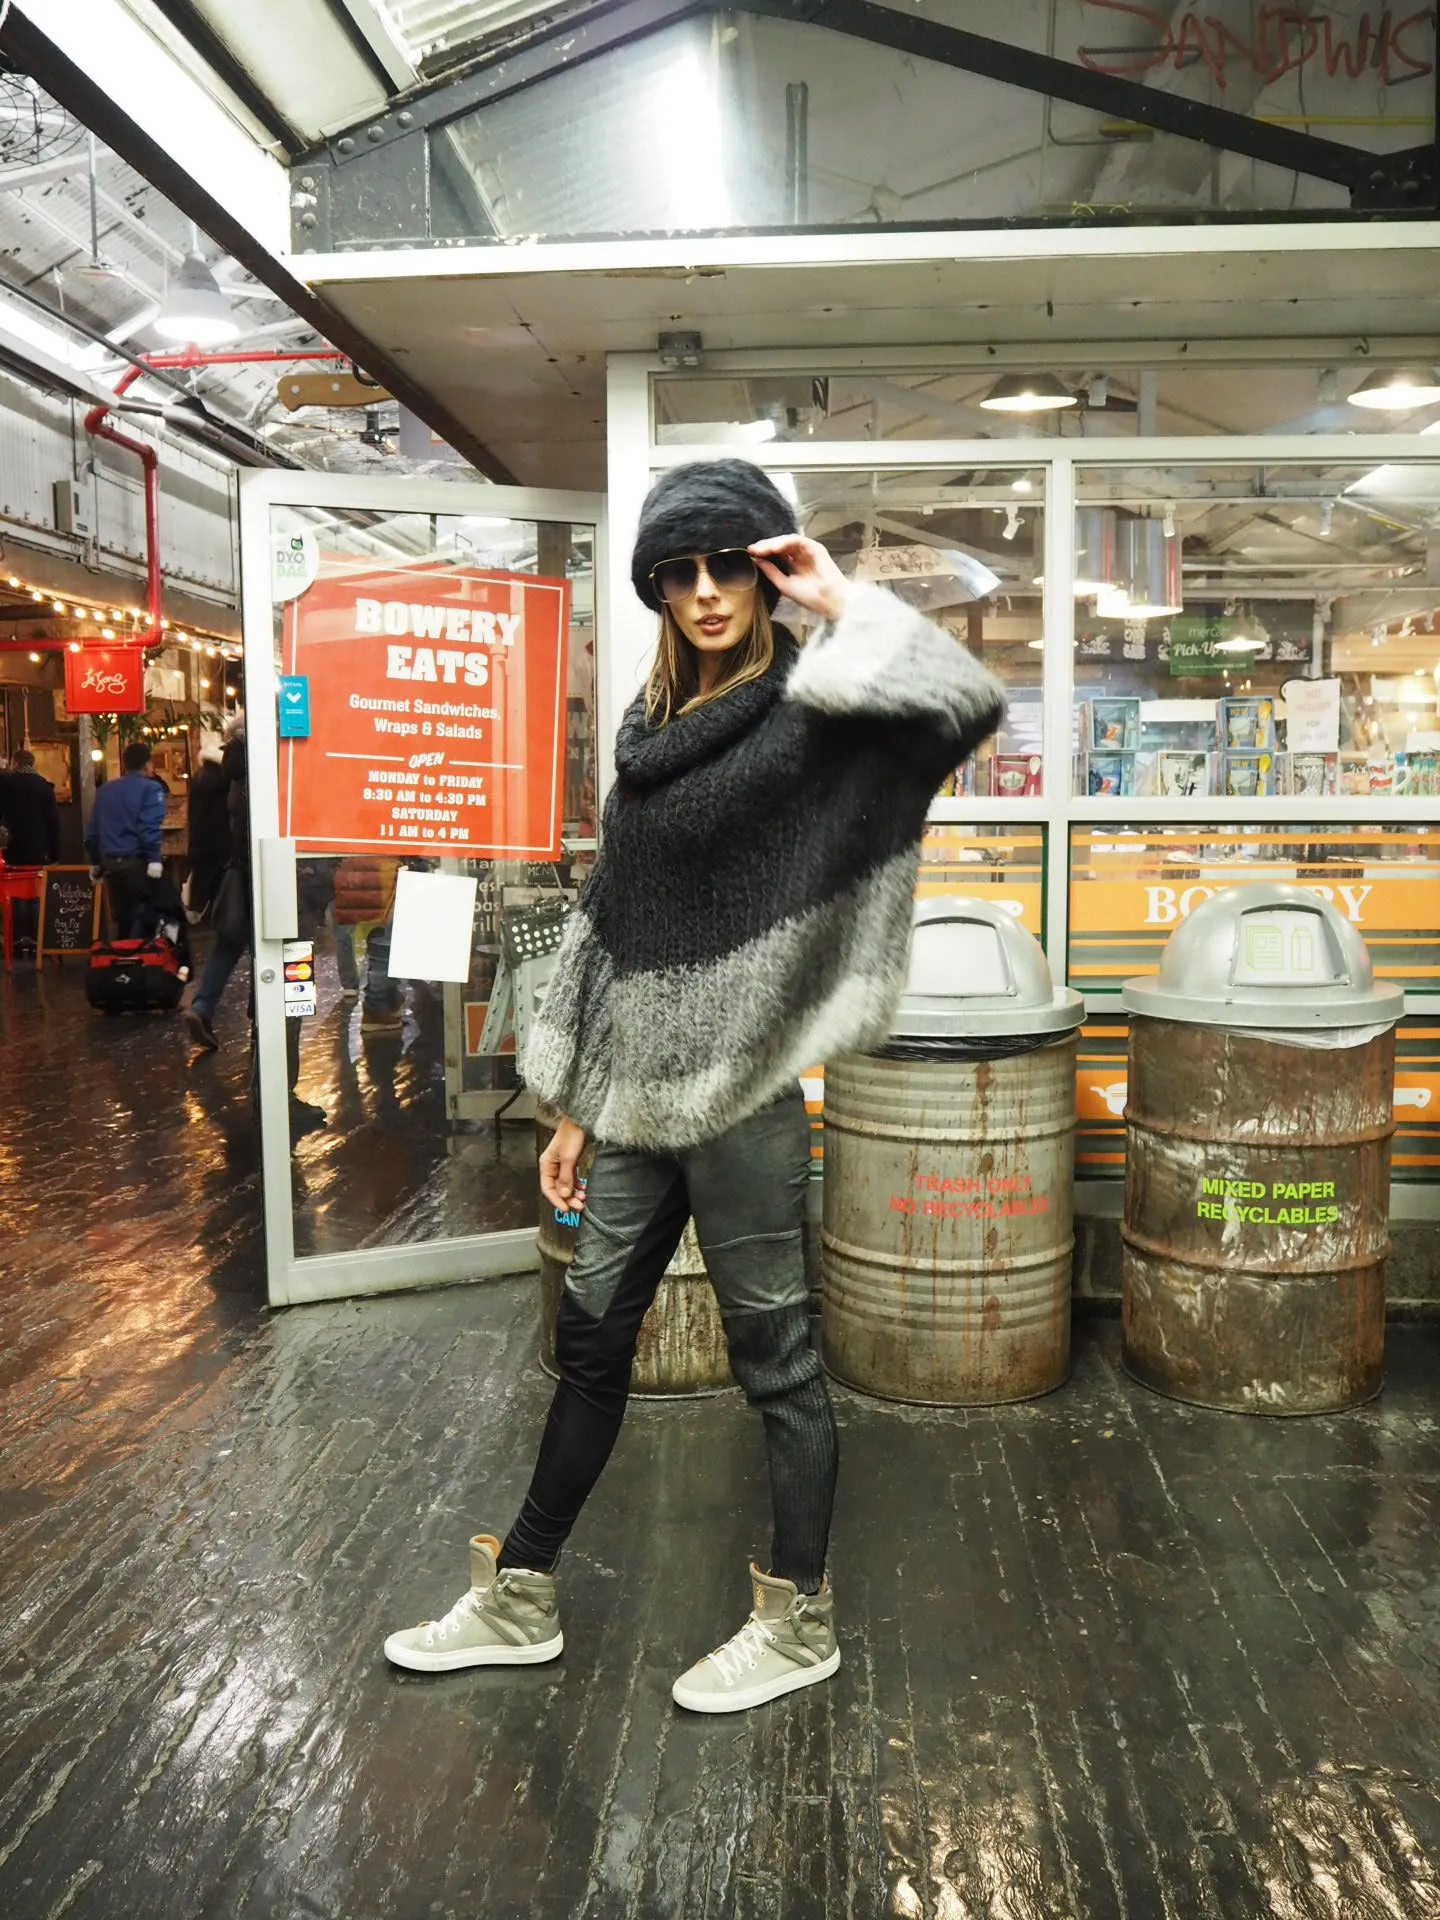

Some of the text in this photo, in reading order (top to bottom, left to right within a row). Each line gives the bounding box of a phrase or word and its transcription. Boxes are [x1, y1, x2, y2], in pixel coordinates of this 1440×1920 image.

[355, 598, 521, 647] BOWERY
[386, 644, 488, 687] EATS
[349, 693, 501, 720] Gourmet Sandwiches,
[374, 717, 483, 739] Wraps & Salads
[408, 752, 445, 769] OPEN
[368, 770, 483, 789] MONDAY to FRIDAY
[363, 788, 486, 807] 8:30 AM to 4:30 PM
[391, 807, 458, 822] SATURDAY
[380, 824, 469, 840] 11 AM to 4 PM
[290, 1004, 312, 1013] VISA
[914, 1174, 1032, 1194] TRASH ONLY
[1202, 1176, 1335, 1199] MIXED PAPER
[889, 1195, 1049, 1219] NO RECYCLABLES
[1197, 1201, 1338, 1224] RECYCLABLES
[554, 1208, 581, 1228] CAN
